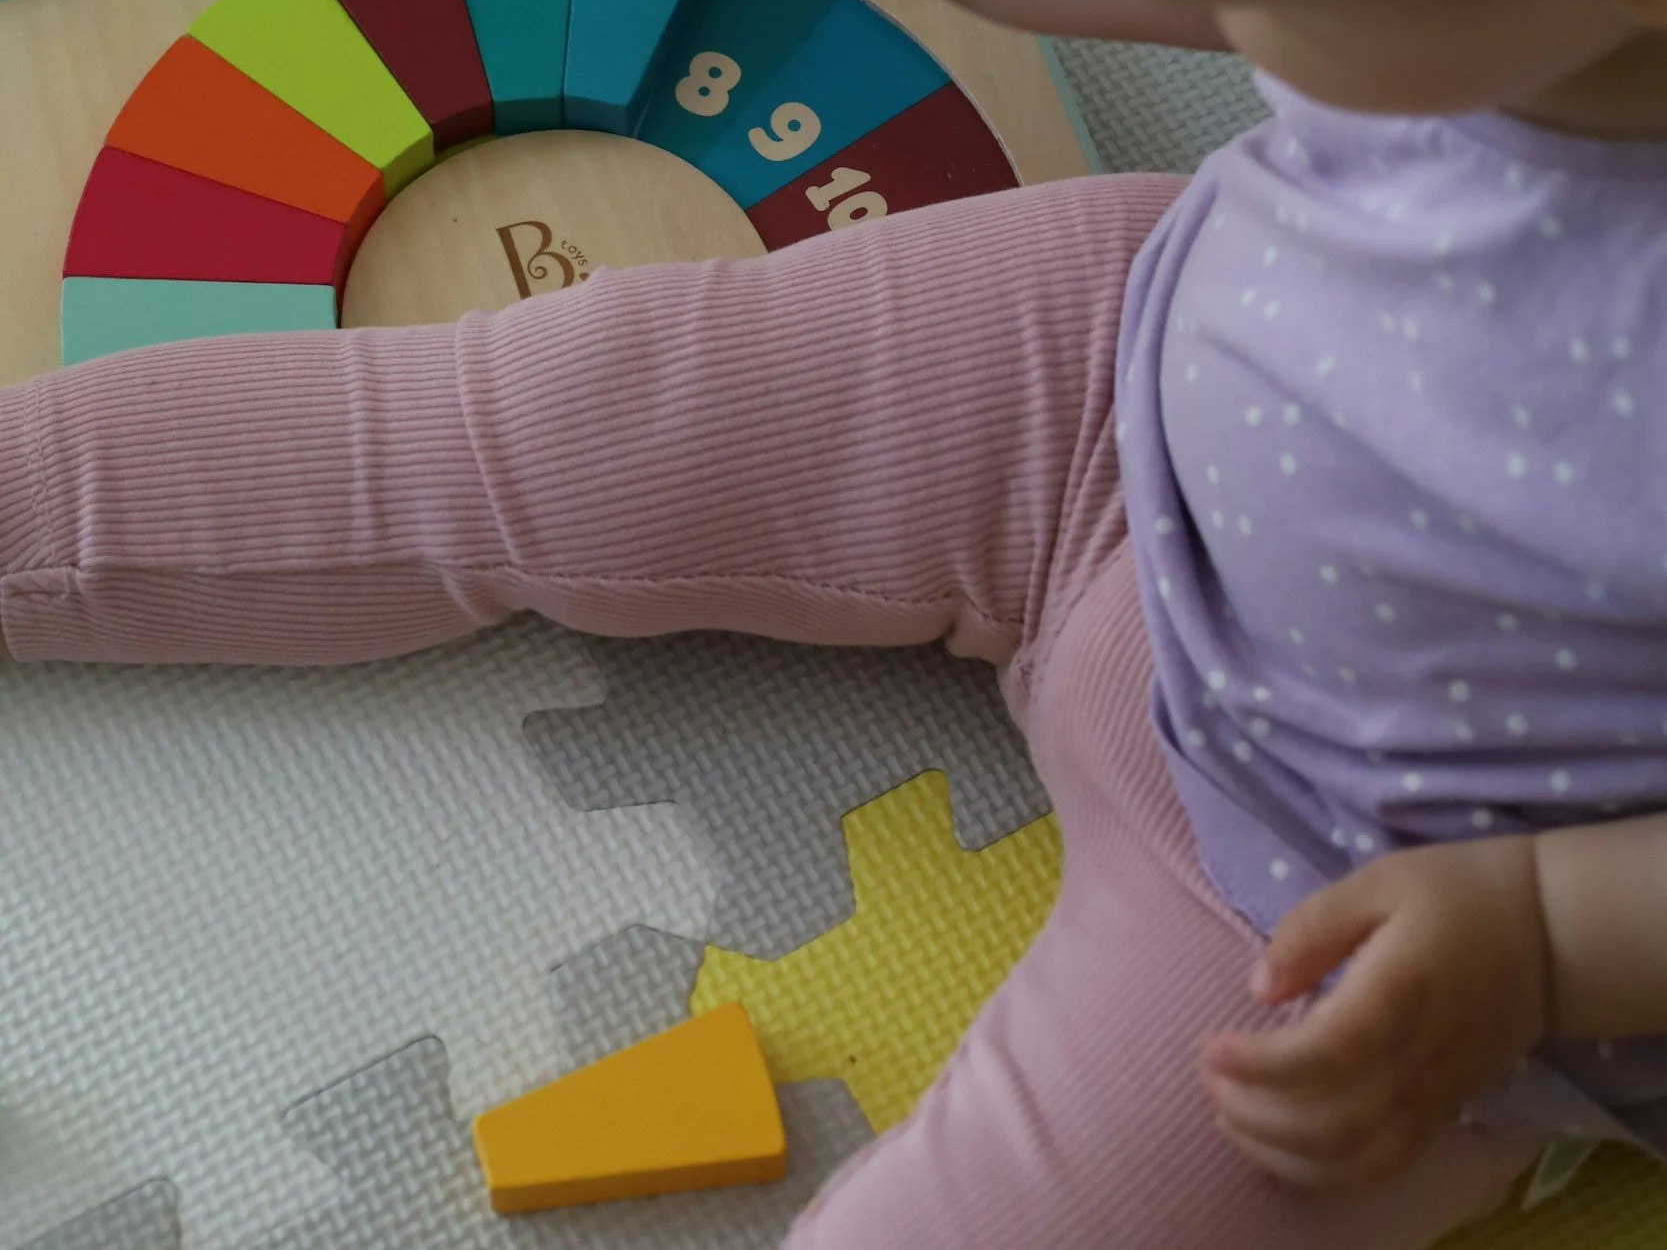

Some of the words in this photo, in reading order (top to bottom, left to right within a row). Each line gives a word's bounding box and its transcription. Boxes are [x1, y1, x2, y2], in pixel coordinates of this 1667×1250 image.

[675, 51, 742, 117] 8
[748, 102, 822, 162] 9
[805, 167, 888, 231] 10
[560, 238, 588, 266] toys
